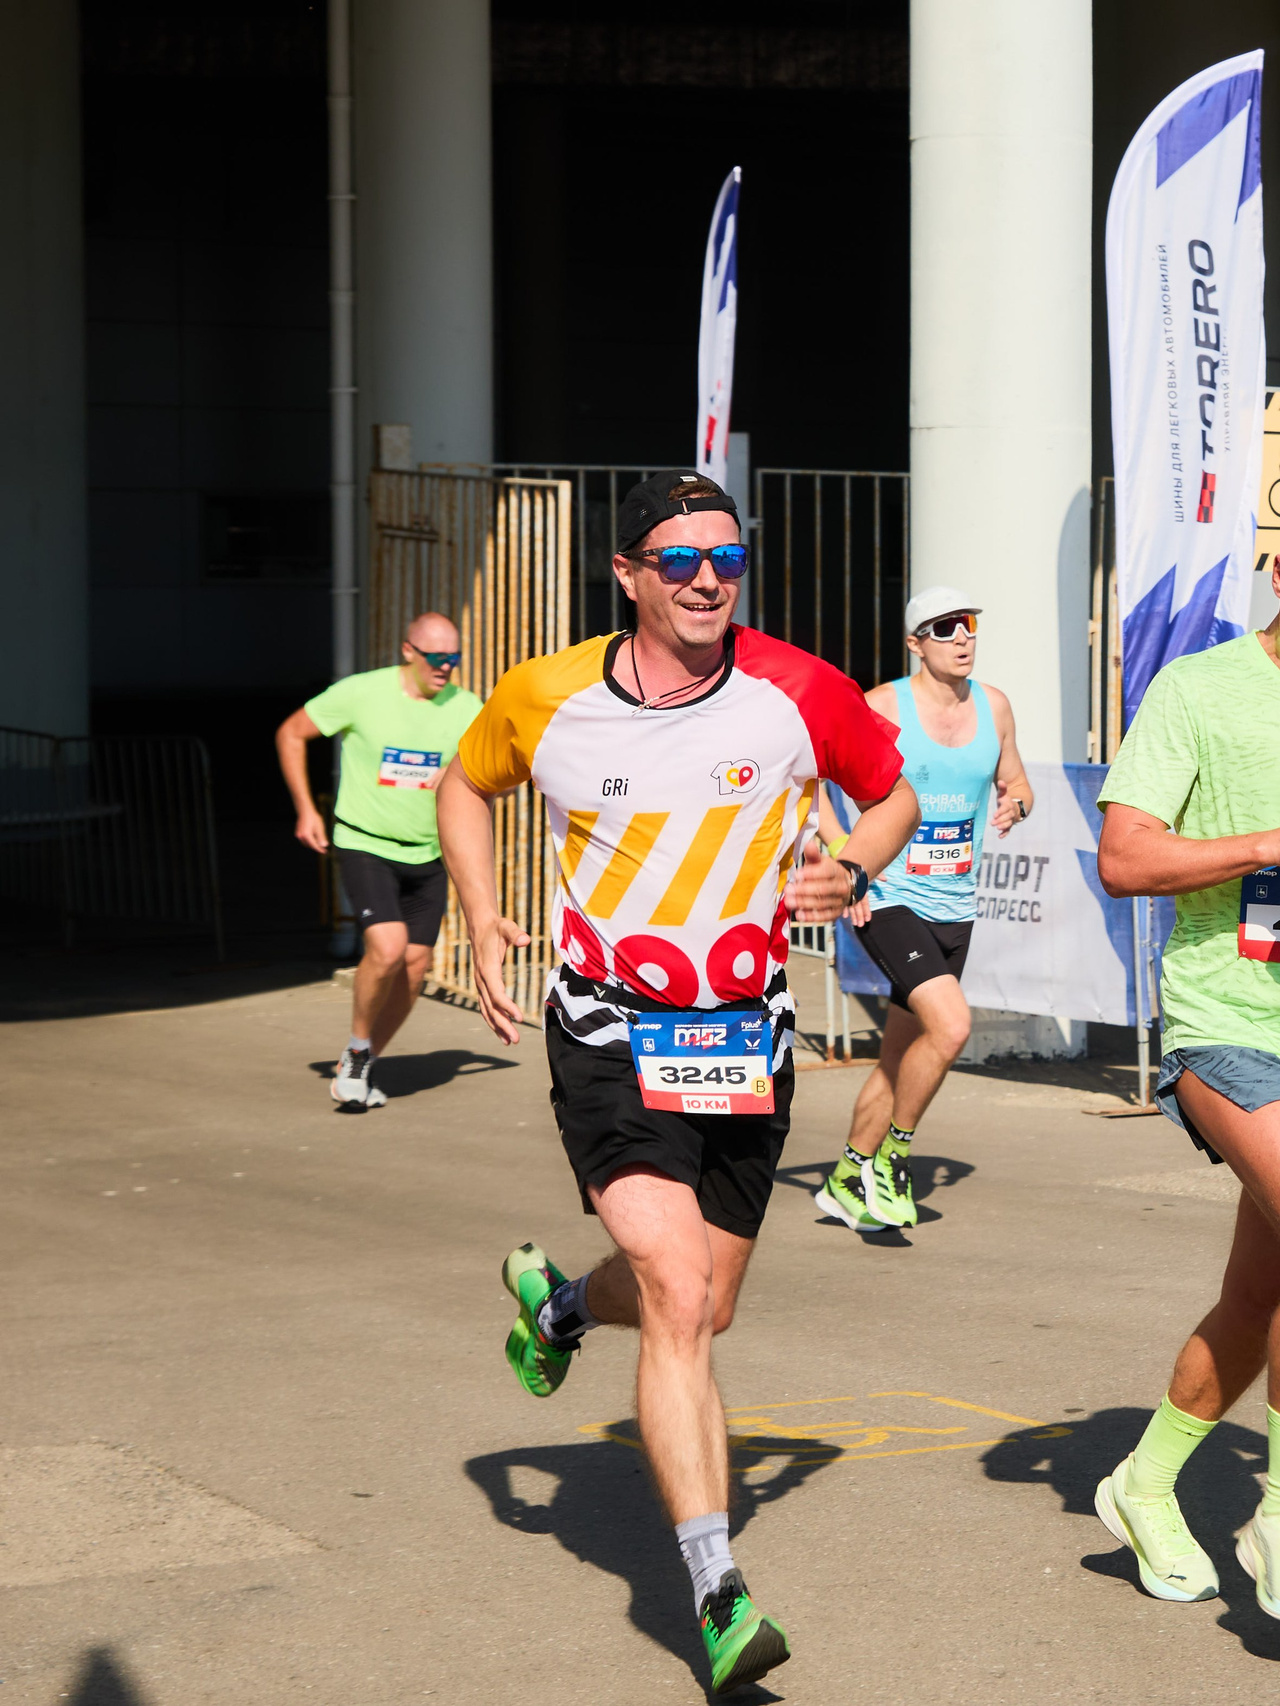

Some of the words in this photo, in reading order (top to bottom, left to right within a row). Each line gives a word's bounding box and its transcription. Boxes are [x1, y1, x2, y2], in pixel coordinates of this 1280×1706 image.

[1158, 243, 1174, 353] АВТОМОБИЛЕЙ
[1168, 360, 1179, 438] ЛЕГКОВЫХ
[1172, 443, 1184, 471] ДЛЯ
[1174, 478, 1184, 523] ШИНЫ
[602, 778, 629, 796] GRi
[928, 849, 960, 860] 1316
[1252, 869, 1278, 877] упер
[658, 1066, 747, 1085] 3245
[685, 1099, 701, 1109] 10
